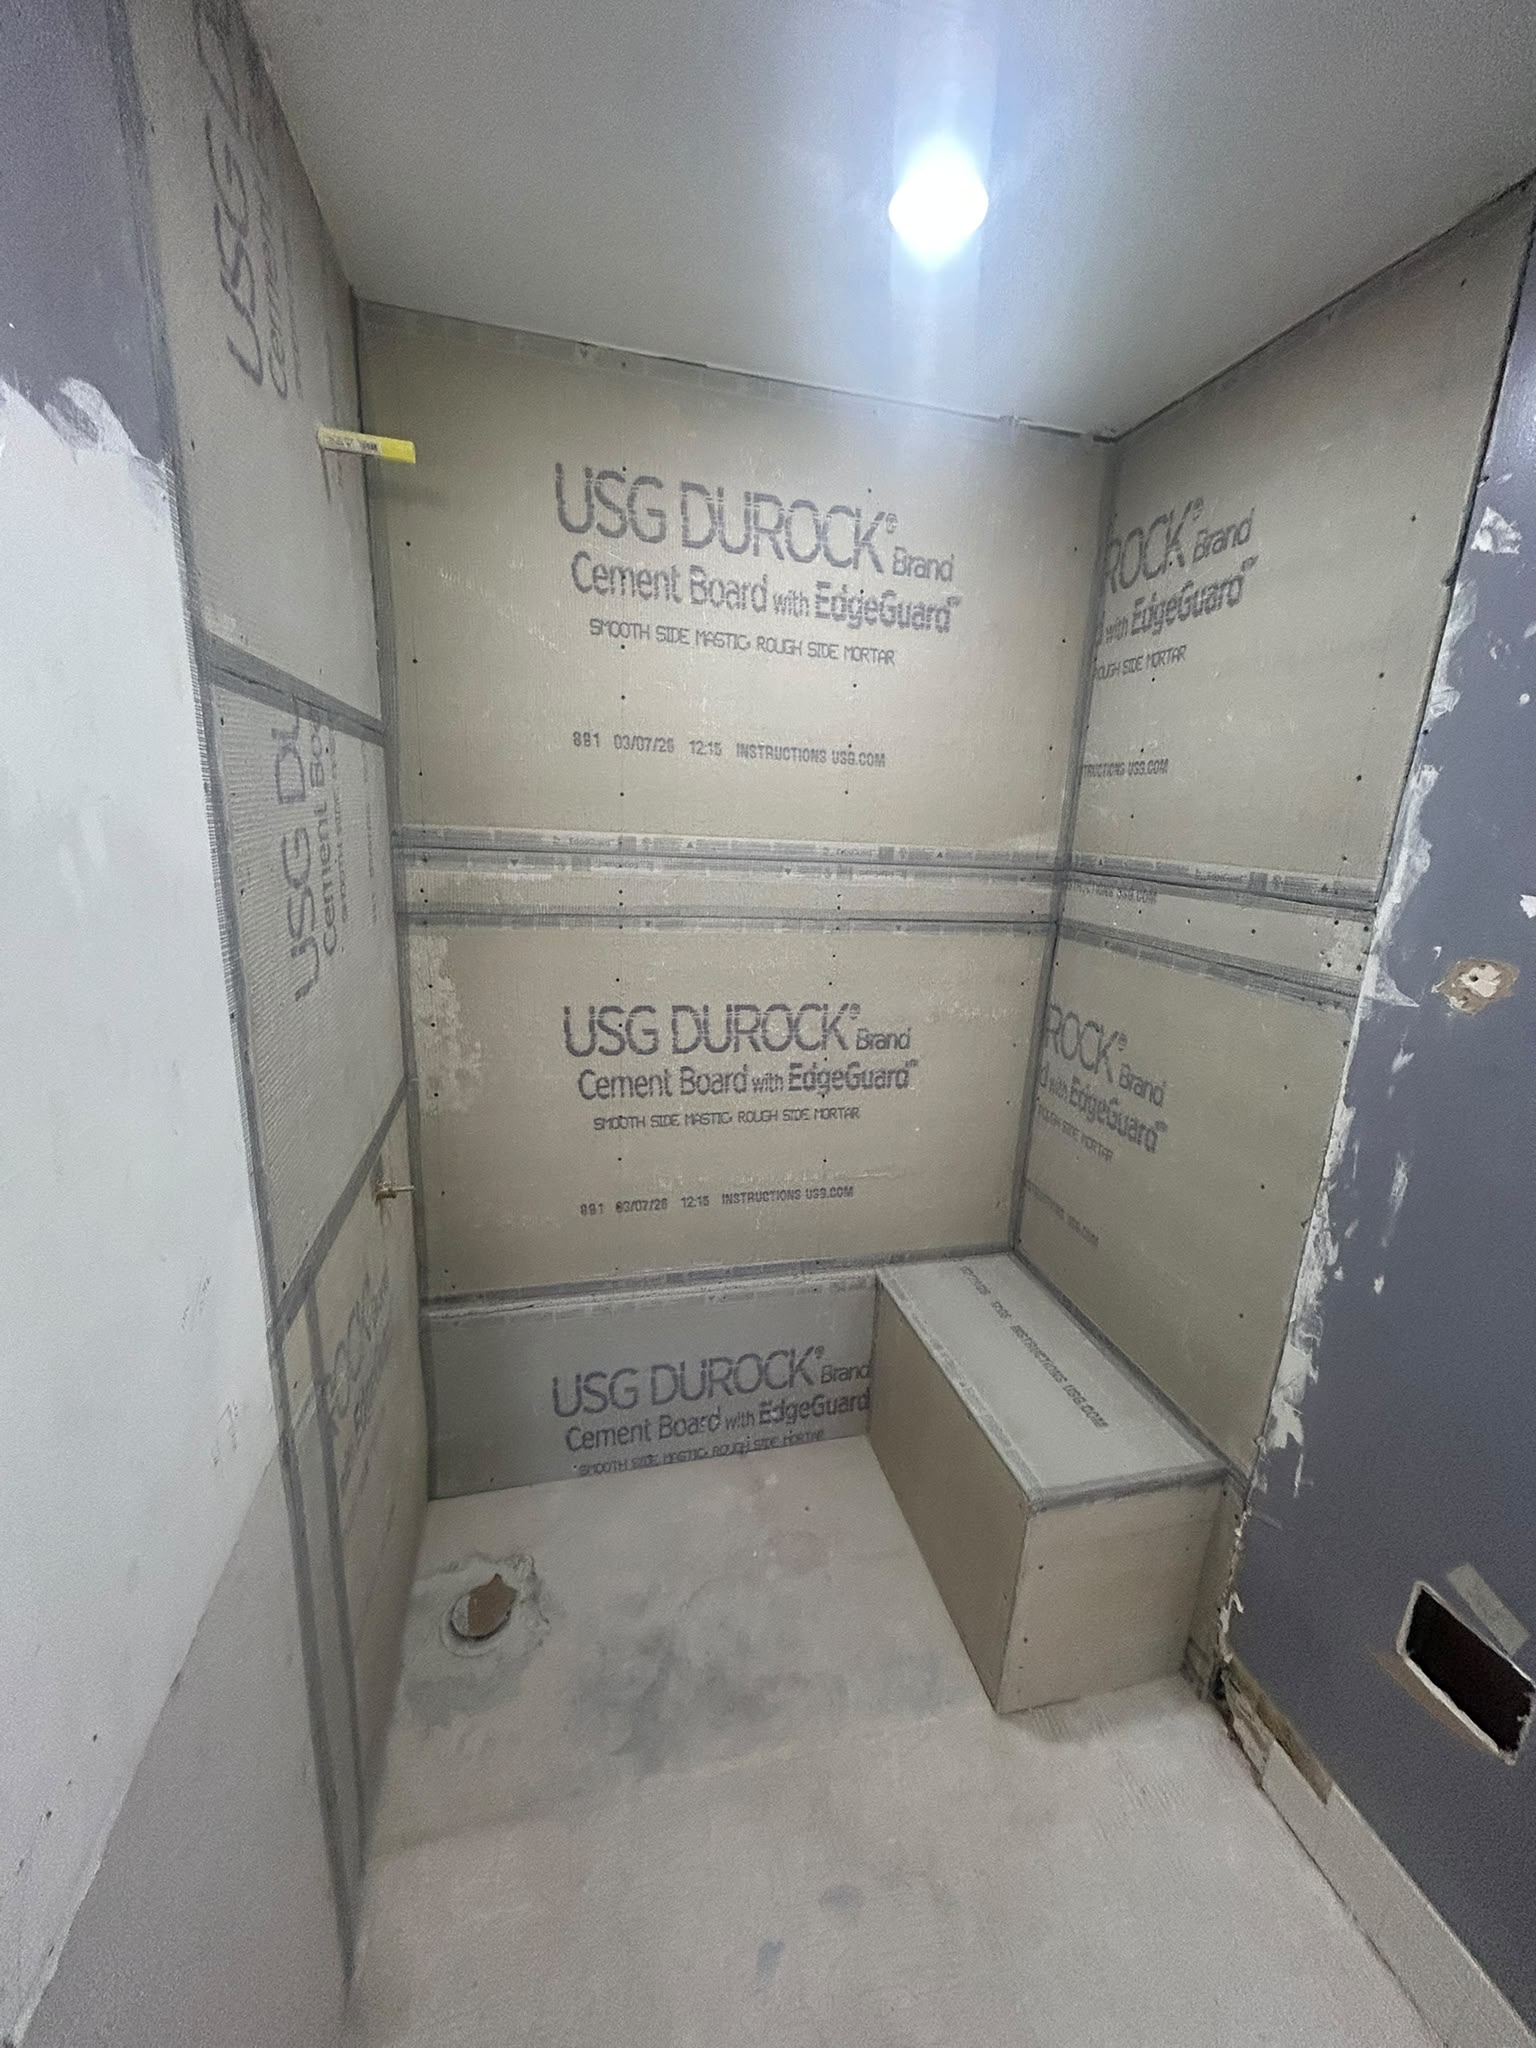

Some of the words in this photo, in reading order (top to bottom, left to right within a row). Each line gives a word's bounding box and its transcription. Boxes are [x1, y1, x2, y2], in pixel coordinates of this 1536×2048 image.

[555, 462, 667, 543] USG
[892, 546, 955, 582] Brand
[1193, 507, 1256, 563] Brand
[571, 551, 680, 604] Cement
[689, 564, 768, 613] Board
[773, 590, 810, 618] with
[589, 617, 651, 641] SMOOTH
[655, 625, 690, 646] SIDE
[756, 635, 803, 657] ROUGH
[807, 641, 839, 661] SIDE
[843, 645, 896, 666] MORTAR
[1122, 656, 1143, 675] SIDE
[1146, 645, 1187, 671] MORTAR
[736, 743, 827, 763] INSTRUCTIONS
[832, 749, 886, 767] USG.COM
[281, 827, 320, 1002] USG
[563, 1004, 660, 1057] USG
[856, 1027, 912, 1050] Brand
[577, 1068, 673, 1100] Cement
[680, 1064, 748, 1096] Board
[752, 1073, 784, 1094] with
[1119, 1062, 1167, 1108] Brand
[593, 1114, 646, 1131] SMOOTH
[650, 1113, 680, 1128] SIDE
[738, 1109, 779, 1124] ROUGH
[782, 1108, 810, 1121] SIDE
[814, 1106, 860, 1121] MORTAR
[721, 1189, 801, 1205] INSTRUCTIONS
[805, 1186, 854, 1200] USG.COM
[552, 1367, 639, 1418] USG
[820, 1361, 871, 1384] Brand
[565, 1422, 651, 1452] Cement
[658, 1406, 722, 1441] Board
[725, 1410, 755, 1431] with
[758, 1387, 871, 1425] EdgeGuard
[578, 1460, 628, 1476] SMOOTH
